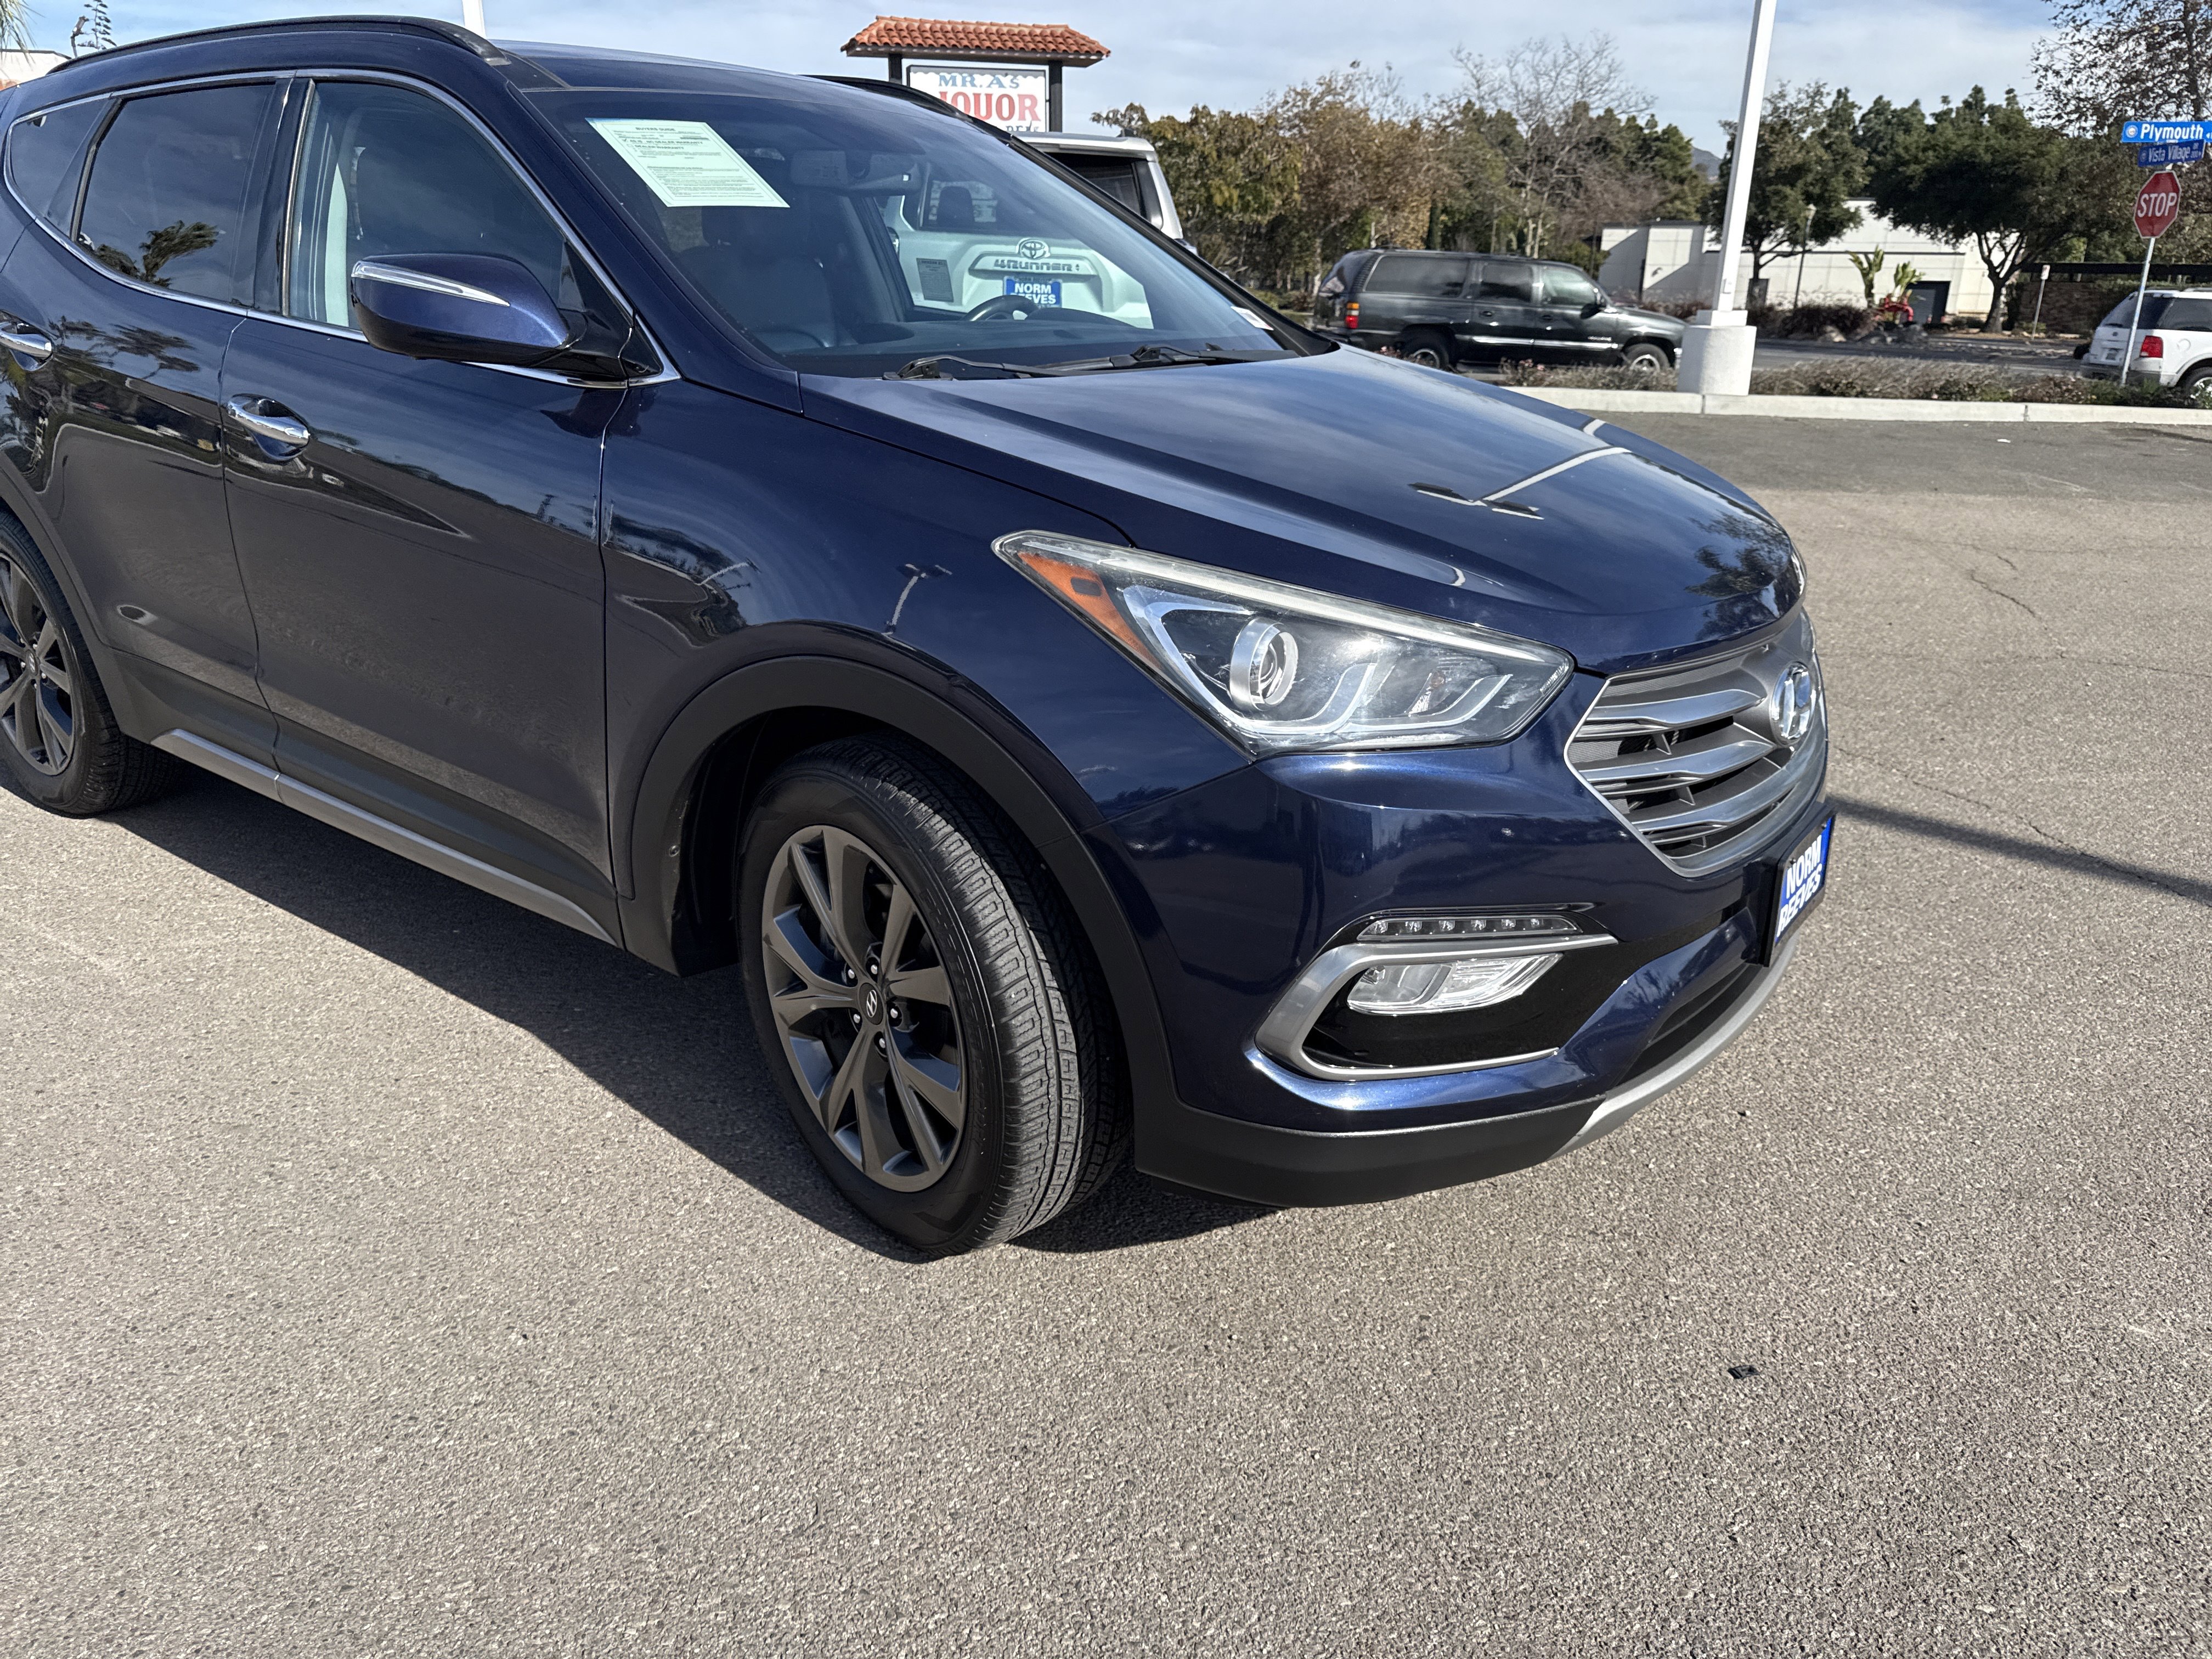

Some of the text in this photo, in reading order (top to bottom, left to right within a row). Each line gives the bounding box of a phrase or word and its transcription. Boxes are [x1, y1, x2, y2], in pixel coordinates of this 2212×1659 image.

[939, 74, 983, 88] MR.
[2140, 123, 2204, 142] Plymouth
[2148, 147, 2166, 162] Vista
[2168, 145, 2191, 162] Village
[2137, 192, 2177, 218] STOP
[1015, 283, 1052, 294] NORM
[1785, 834, 1822, 899] NORM
[1776, 864, 1822, 938] REEVES
